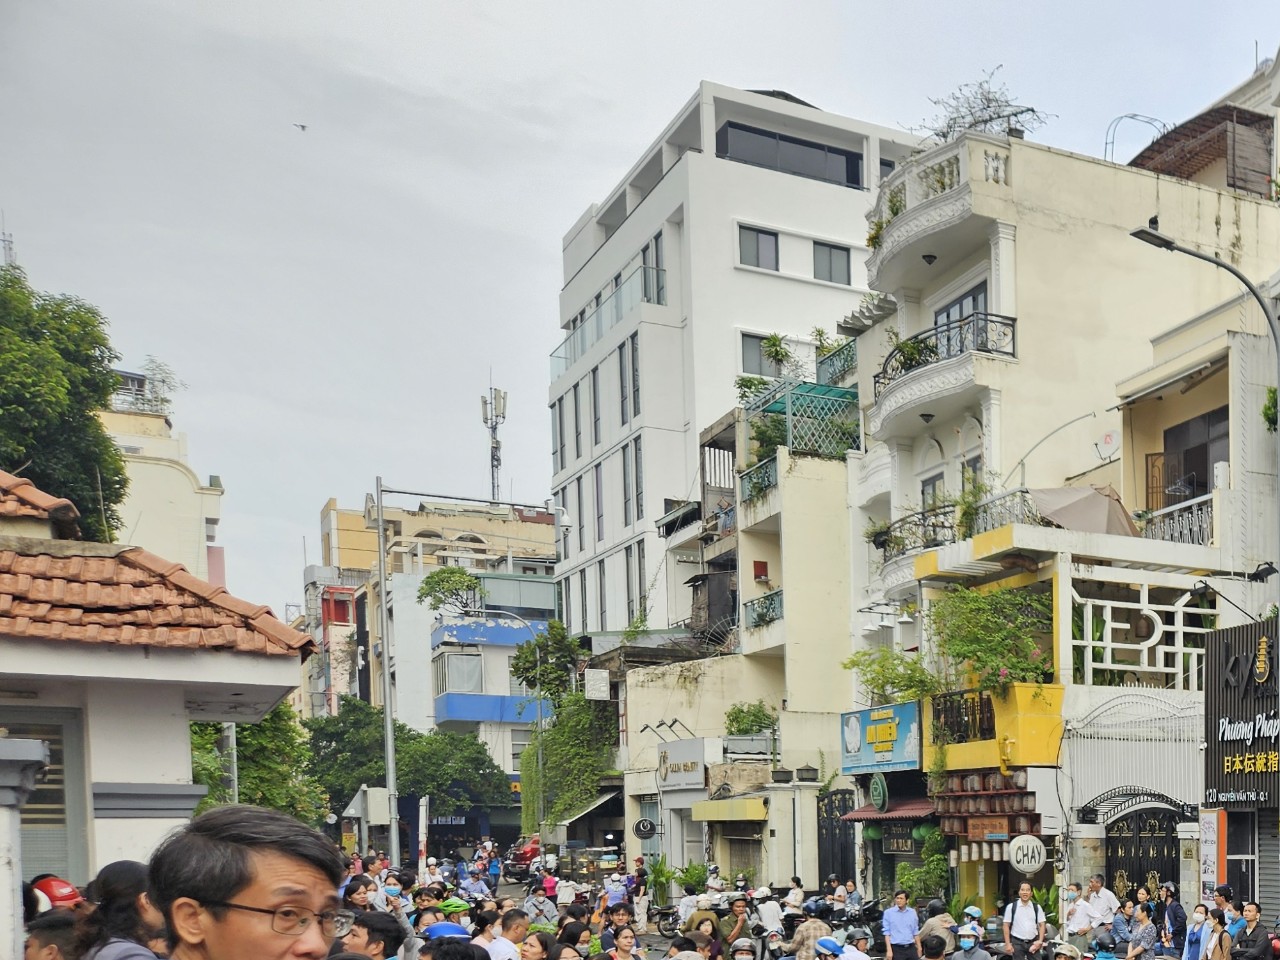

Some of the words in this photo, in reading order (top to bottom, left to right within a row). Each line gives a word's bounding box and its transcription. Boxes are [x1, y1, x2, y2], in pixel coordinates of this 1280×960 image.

[1218, 716, 1254, 746] Phương
[1254, 709, 1280, 744] Pháp
[1206, 788, 1217, 803] 120
[1016, 844, 1042, 865] CHAY
